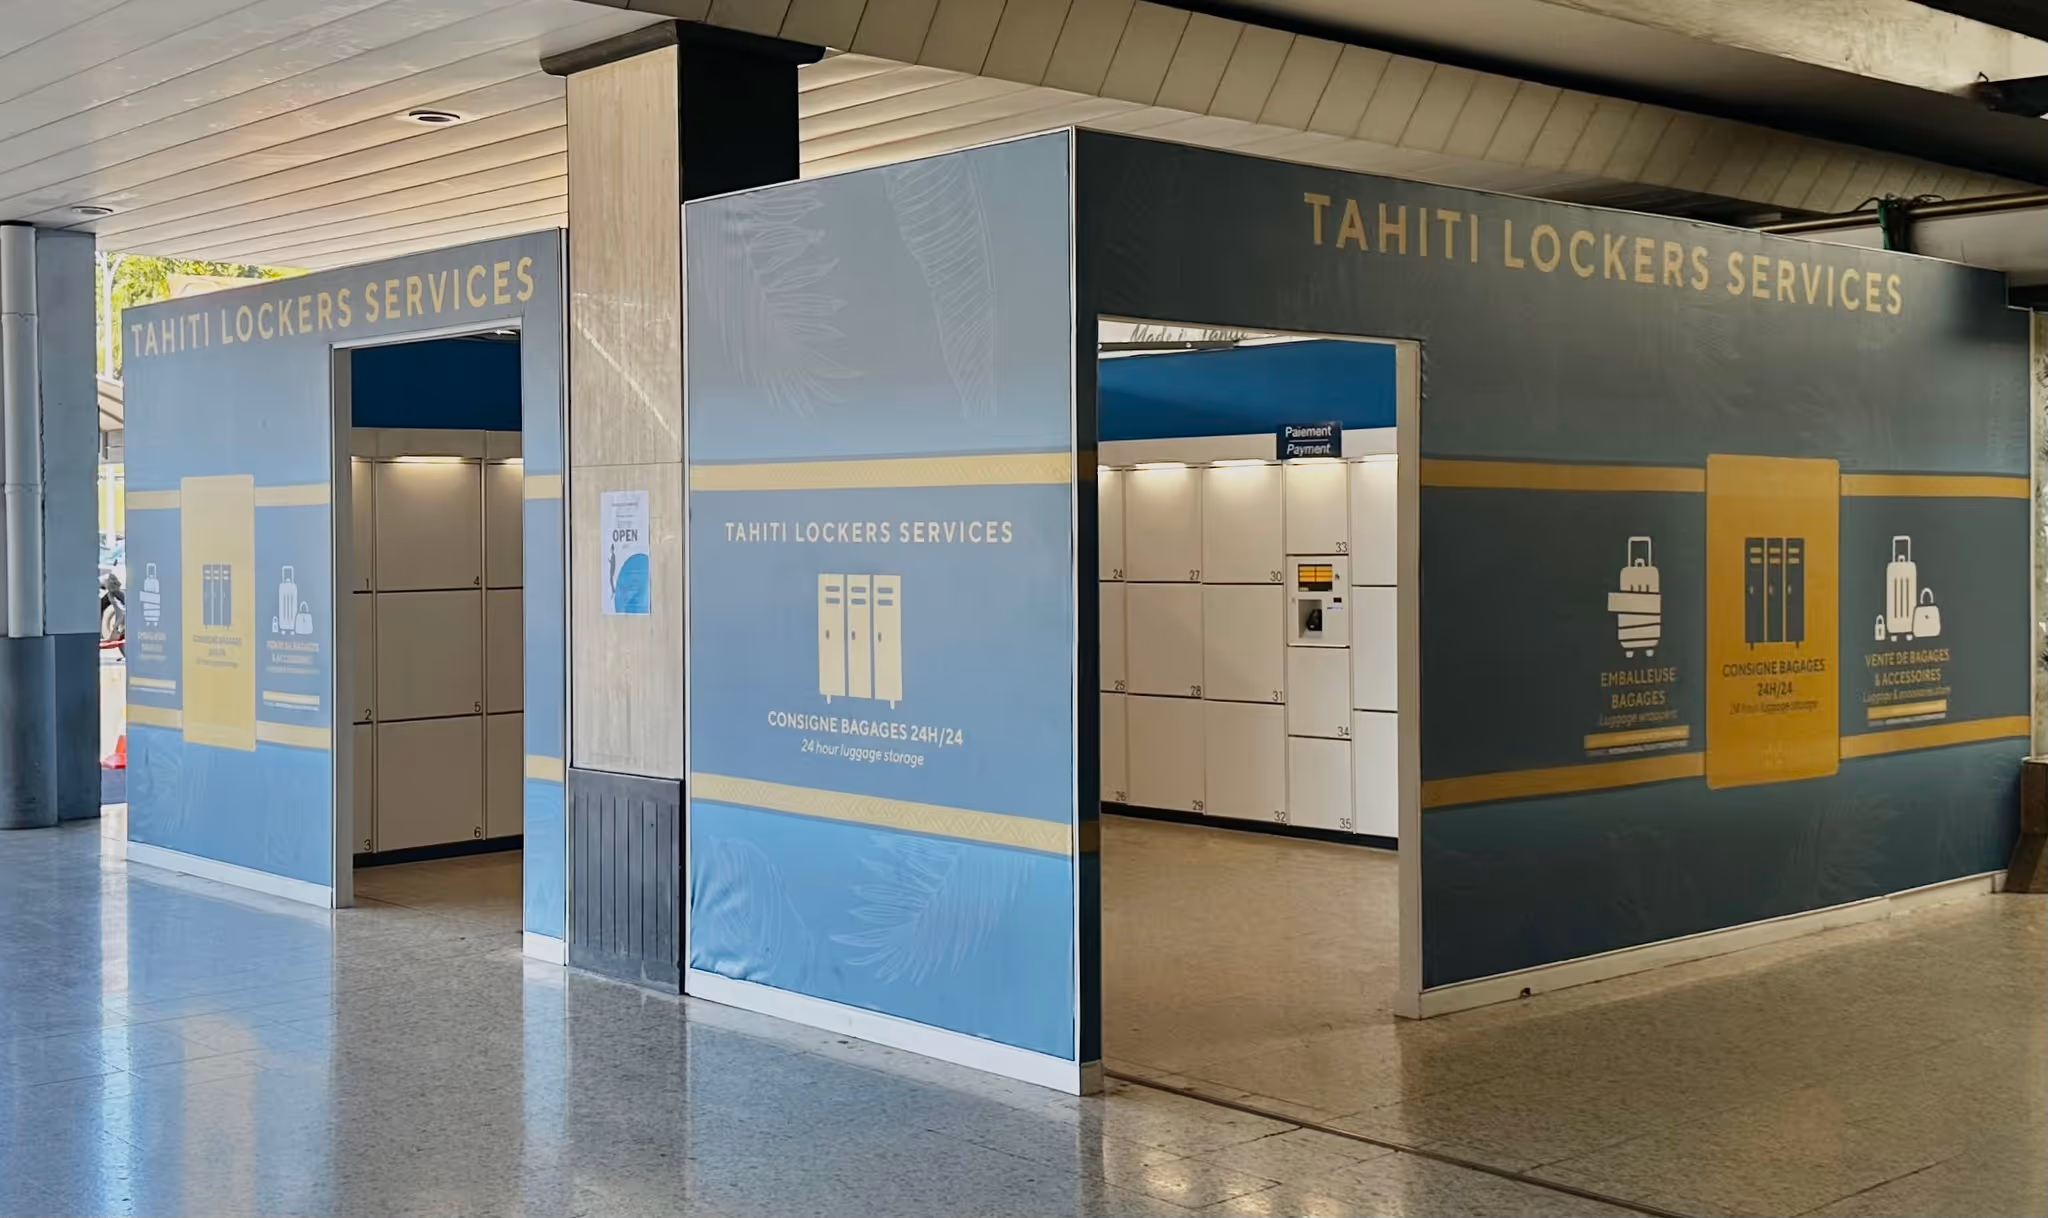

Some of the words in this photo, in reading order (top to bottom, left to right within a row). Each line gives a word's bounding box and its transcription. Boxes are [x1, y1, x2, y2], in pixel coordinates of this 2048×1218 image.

[1303, 192, 1480, 263] TAHITI
[1504, 219, 1709, 291] LOCKERS
[1727, 251, 1903, 315] SERVICES
[130, 312, 210, 358] TAHITI
[220, 287, 352, 344] LOCKERS
[365, 256, 535, 323] SERVICES
[1285, 425, 1332, 438] Paiement
[1286, 443, 1331, 457] Payment
[612, 529, 638, 542] OPEN
[725, 522, 787, 543] TAHITI
[795, 522, 891, 543] LOCKERS
[899, 521, 1013, 543] SERVICES
[1335, 541, 1348, 553] 33
[1113, 569, 1124, 579] 24
[1189, 570, 1200, 581] 27
[1270, 570, 1282, 582] 30
[473, 576, 481, 586] 4
[1864, 652, 1895, 668] VENTE
[1896, 650, 1908, 665] DE
[1909, 648, 1951, 664] BAGAGES
[1722, 660, 1777, 678] CONSIGNE
[1778, 658, 1826, 675] BAGAGES
[1600, 667, 1678, 688] EMBALLEUSE
[1882, 668, 1941, 686] ACCESSOIRES
[1114, 680, 1125, 691] 25
[1190, 686, 1201, 697] 28
[1757, 682, 1793, 698] 24H/24
[1272, 691, 1283, 702] 31
[1611, 690, 1666, 709] BAGAGES
[474, 702, 481, 712] 5
[364, 709, 372, 720] 2
[767, 710, 838, 733] CONSIGNE
[841, 718, 907, 740] BAGAGES
[910, 725, 964, 748] 24H/24
[1337, 727, 1349, 738] 34
[801, 738, 814, 753] 24
[816, 740, 839, 755] hour
[840, 744, 882, 763] luggage
[884, 748, 924, 768] storage
[1192, 800, 1203, 811] 29
[1274, 811, 1286, 823] 32
[1339, 818, 1351, 830] 35
[474, 827, 481, 838] 6
[363, 839, 371, 851] 3
